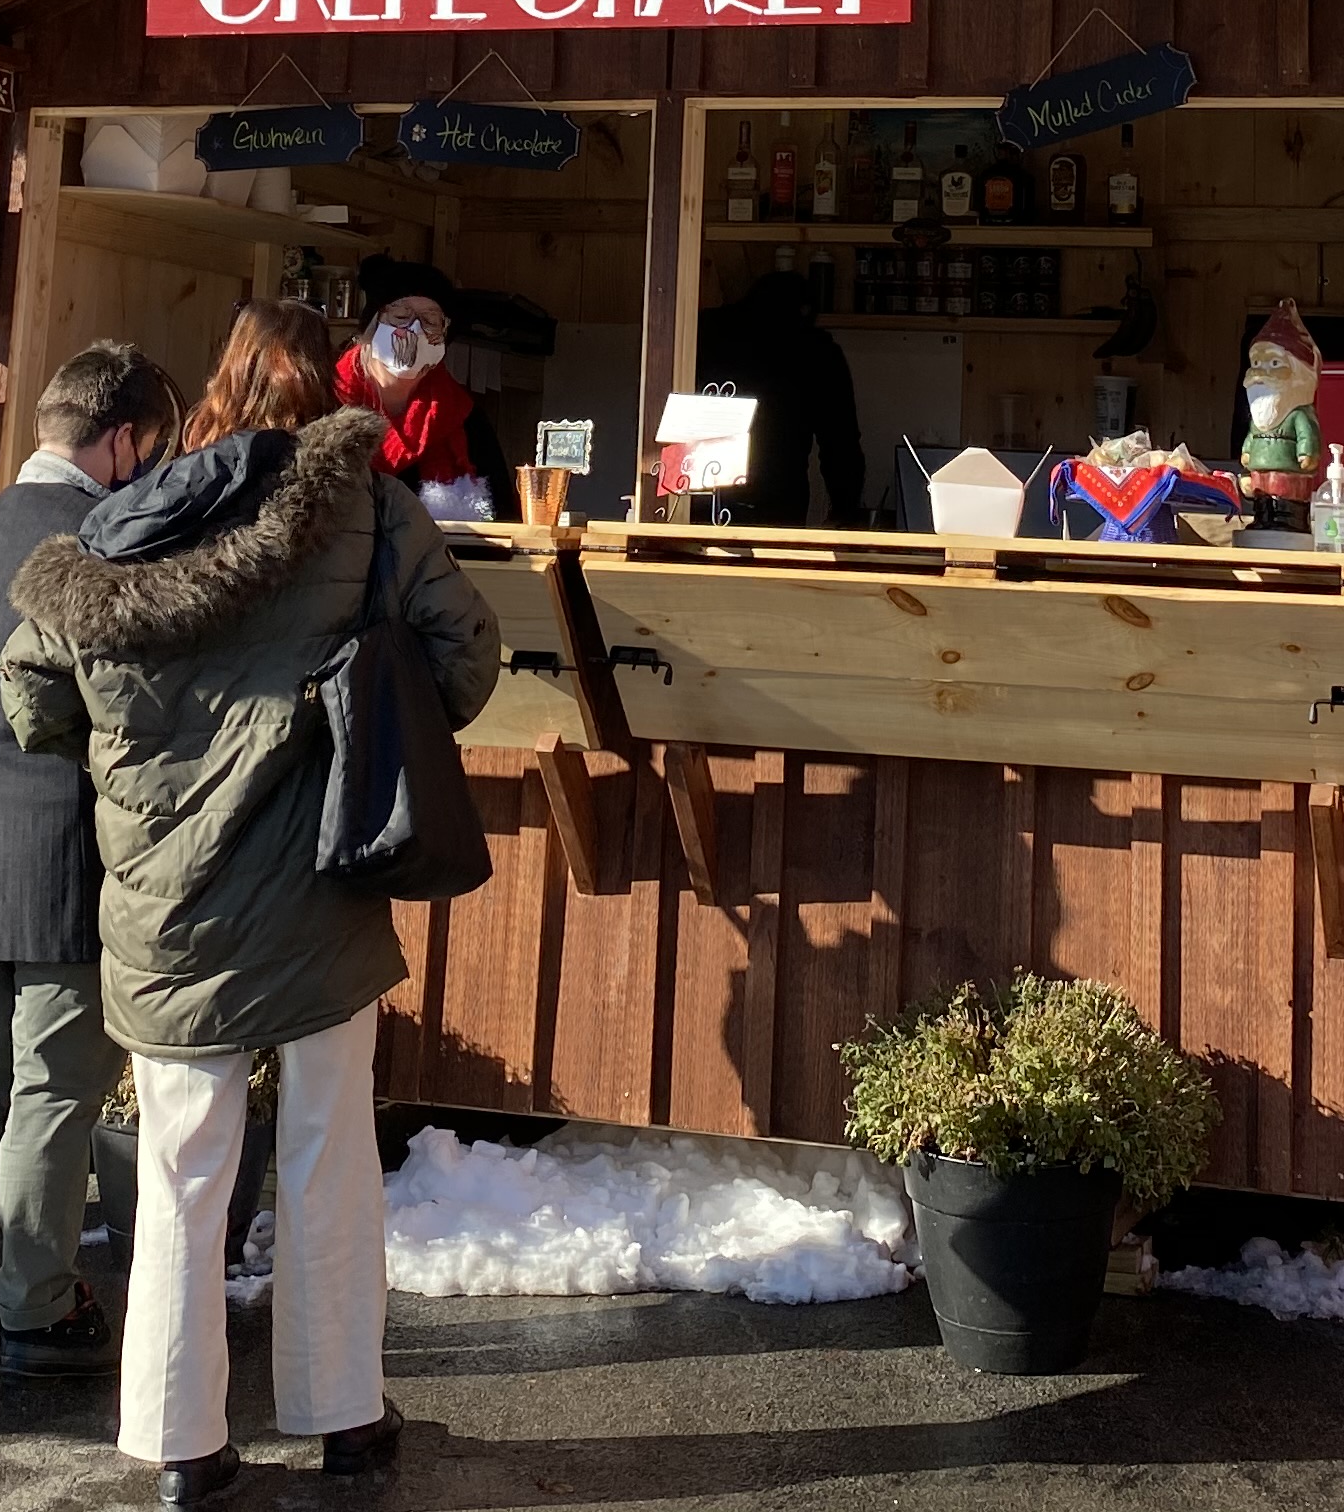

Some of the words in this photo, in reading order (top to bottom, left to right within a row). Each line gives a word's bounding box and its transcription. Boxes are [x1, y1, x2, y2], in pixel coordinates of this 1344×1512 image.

[1027, 91, 1094, 137] Mulled
[1097, 77, 1157, 113] Cider
[436, 113, 475, 151] Hot
[481, 123, 565, 156] Chocolate
